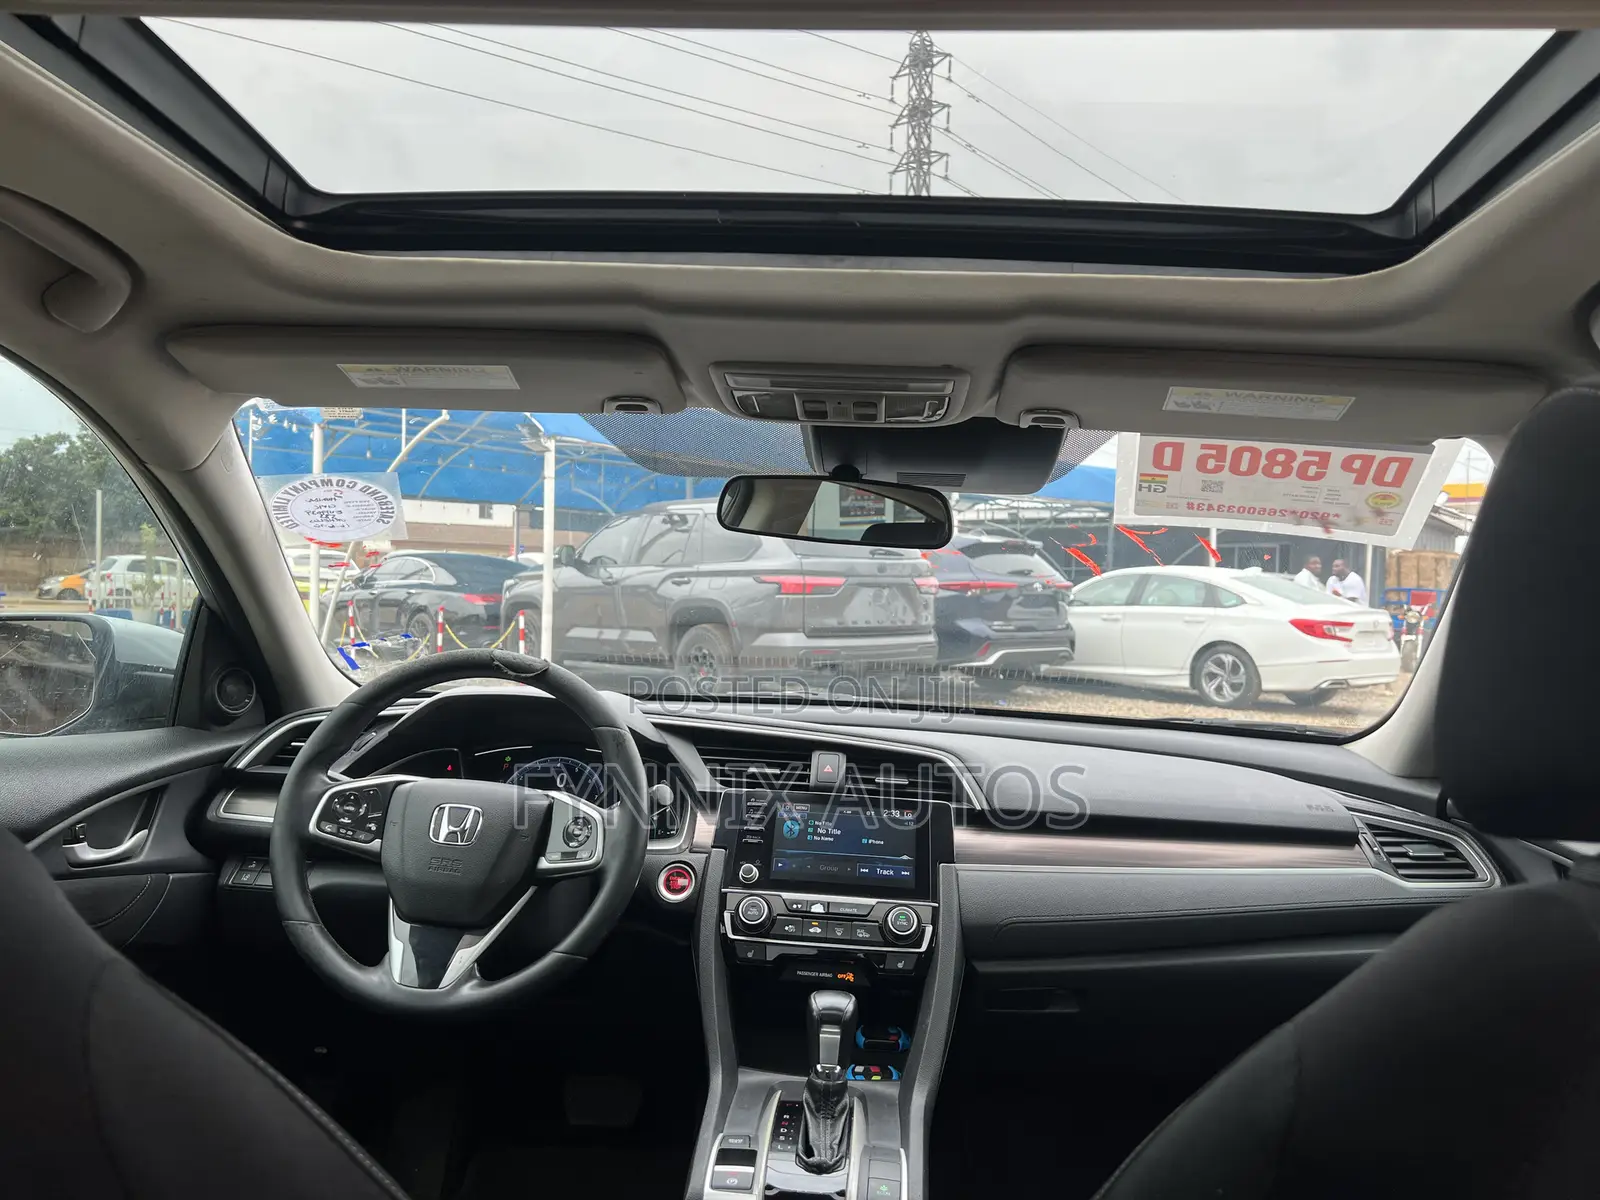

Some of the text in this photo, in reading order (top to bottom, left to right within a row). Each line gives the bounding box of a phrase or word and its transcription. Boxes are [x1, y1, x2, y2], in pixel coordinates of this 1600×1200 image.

[393, 366, 487, 374] WARNING
[1225, 391, 1324, 404] WARNING
[883, 809, 900, 818] 2:33
[820, 864, 839, 872] Group
[876, 868, 894, 876] Track
